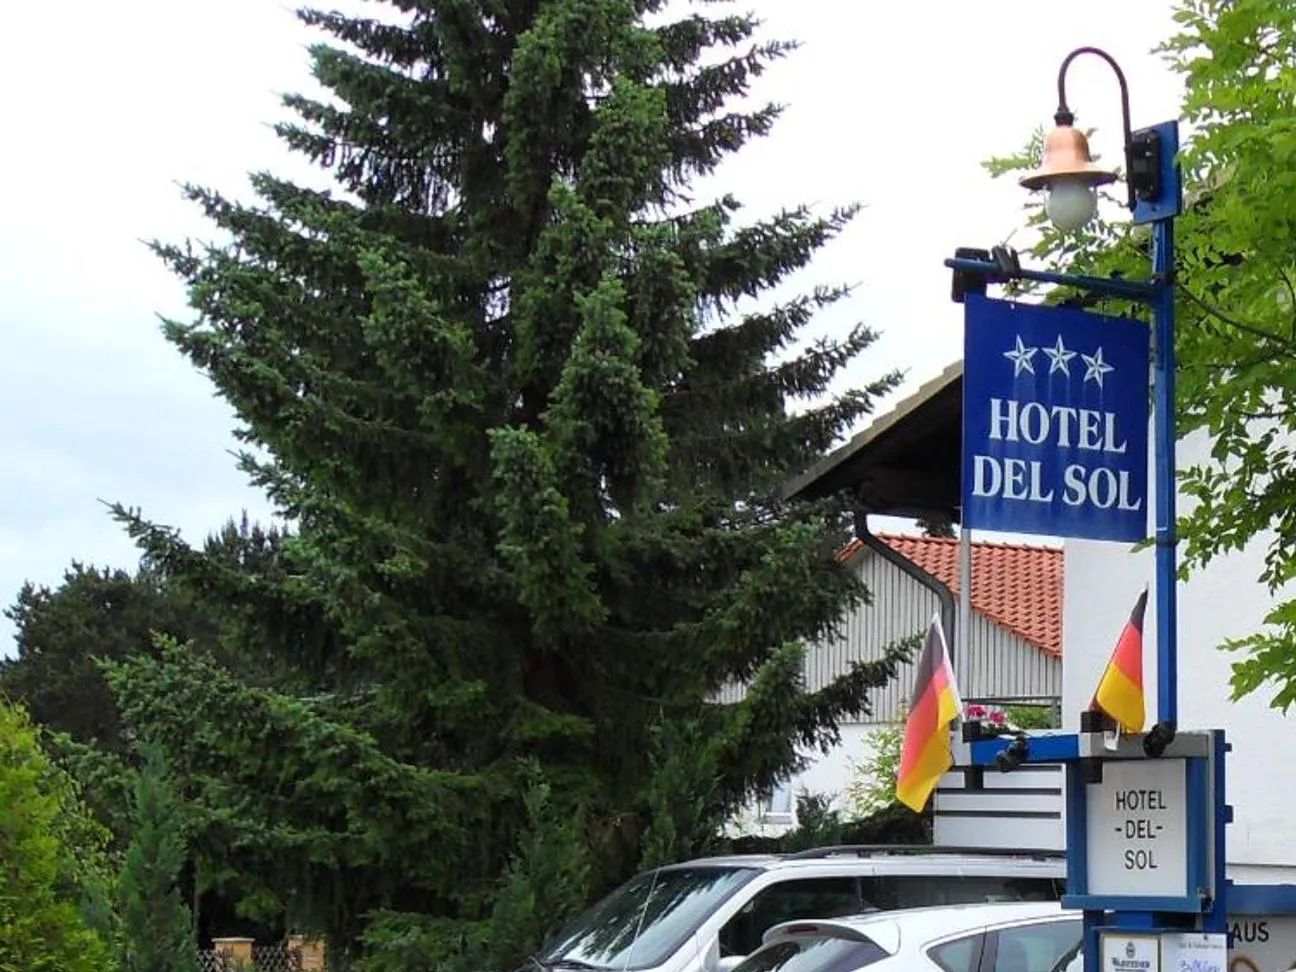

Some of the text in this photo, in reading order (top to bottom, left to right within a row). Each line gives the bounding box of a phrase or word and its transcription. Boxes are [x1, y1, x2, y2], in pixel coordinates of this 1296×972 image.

[988, 397, 1128, 453] HOTEL
[972, 455, 1142, 511] DEL SOL
[1115, 789, 1167, 810] HOTEL
[1124, 849, 1158, 870] SOL
[1226, 920, 1269, 942] AUS
